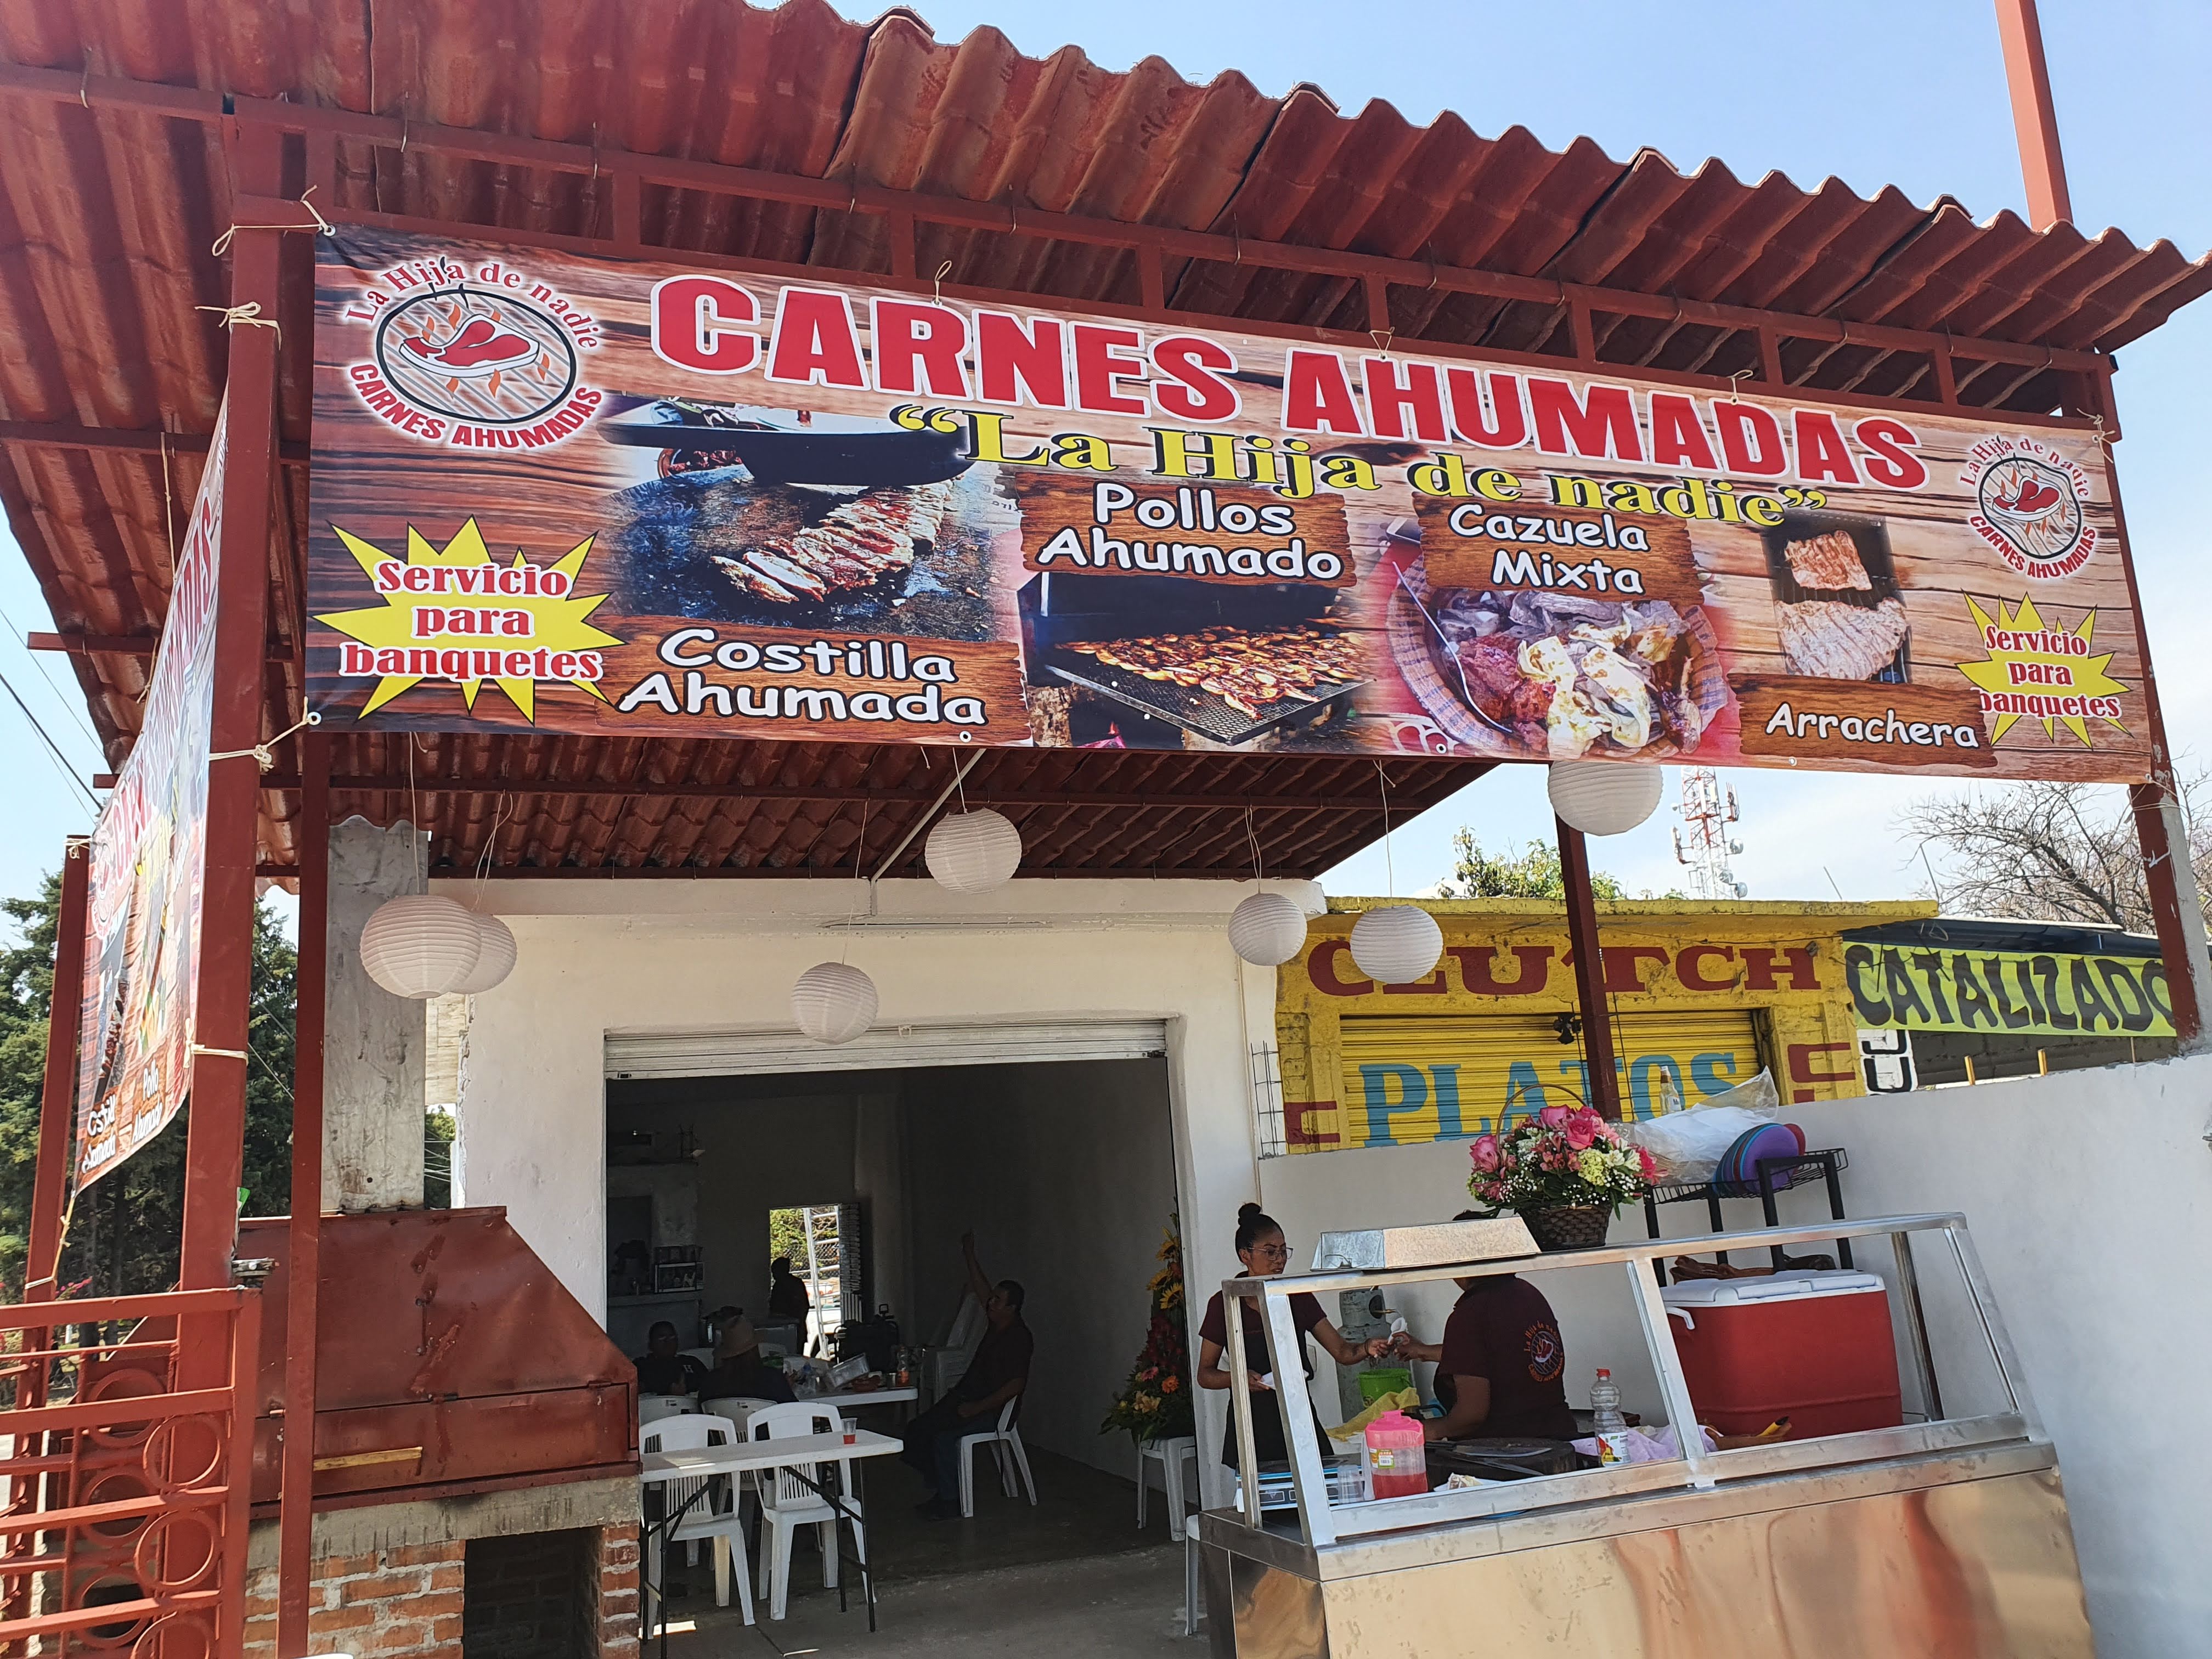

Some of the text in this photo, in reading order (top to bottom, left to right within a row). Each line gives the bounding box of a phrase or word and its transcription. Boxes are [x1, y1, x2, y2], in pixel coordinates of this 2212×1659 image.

[346, 260, 597, 349] La Hija de nadie
[351, 364, 602, 448] CARNES AHUMADAS
[653, 276, 1928, 490] CARNES AHUMADAS
[1142, 426, 1383, 499] Hija
[1408, 452, 1522, 501] de
[1960, 438, 2089, 497] La Hija de nadie
[1094, 481, 1296, 536] Pollos
[1449, 503, 1650, 552] Cazuela
[1037, 526, 1343, 581] Ahumado
[1491, 549, 1645, 595] Mixta
[1970, 516, 2096, 579] CARNES AHUMADAS
[378, 562, 568, 596] Servicio
[415, 607, 531, 637] para
[1985, 625, 2086, 656] Servicio
[344, 645, 599, 680] banquetes
[658, 627, 958, 685] Costilla
[2009, 661, 2072, 685] para
[616, 670, 989, 726] Ahumada
[1765, 702, 1980, 748] Arrachera
[1976, 689, 2121, 718] banquetes
